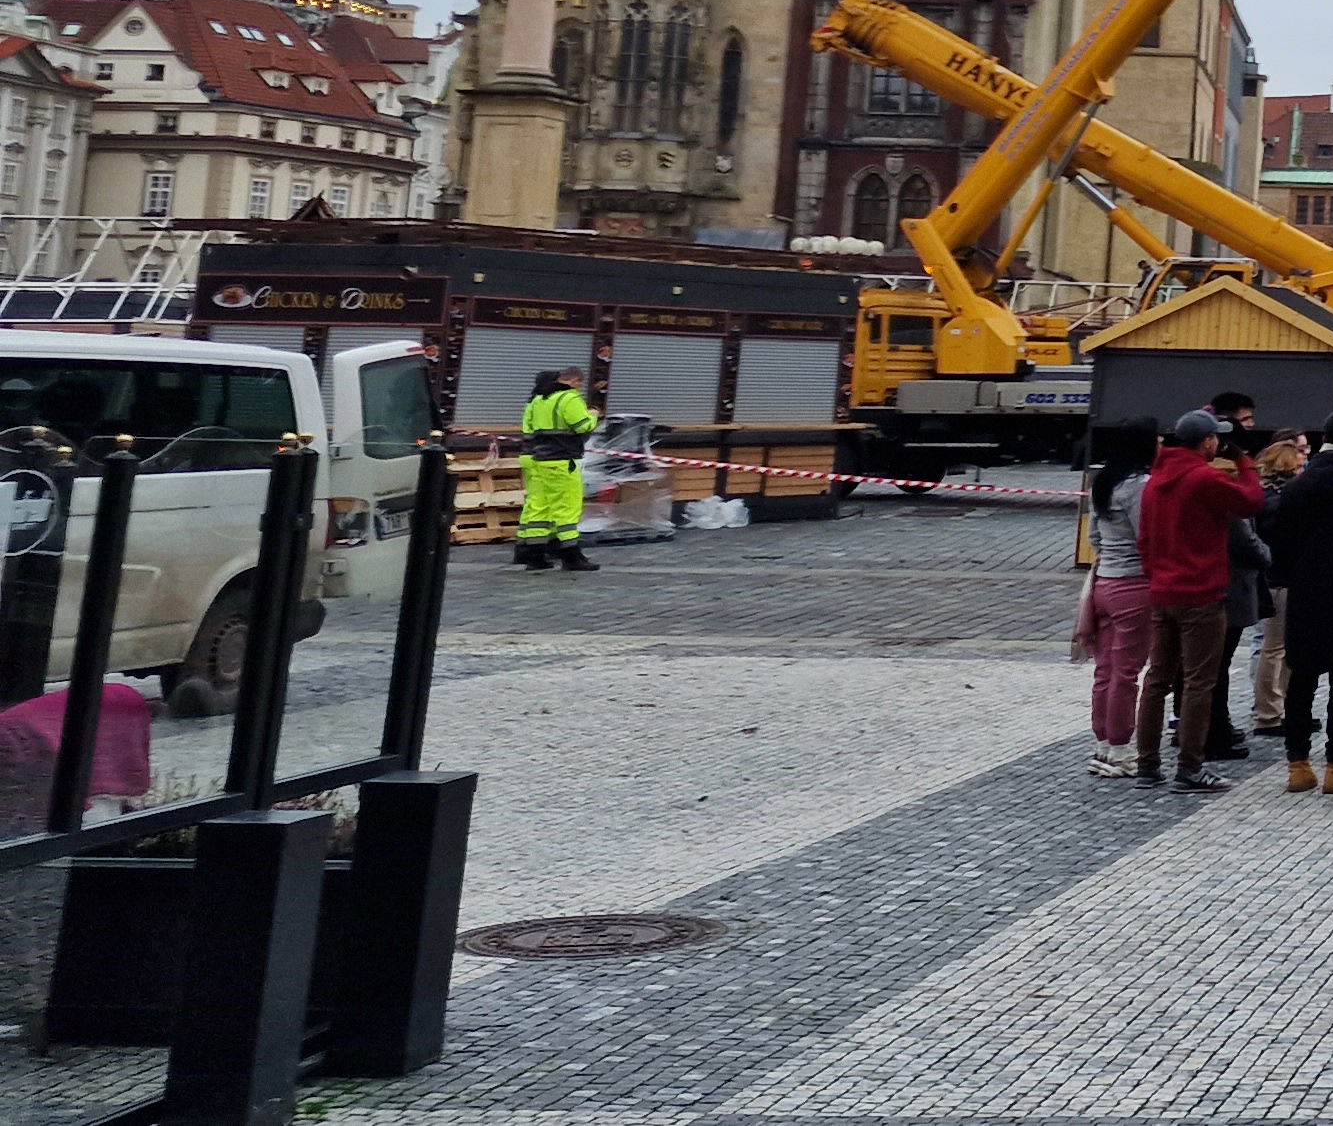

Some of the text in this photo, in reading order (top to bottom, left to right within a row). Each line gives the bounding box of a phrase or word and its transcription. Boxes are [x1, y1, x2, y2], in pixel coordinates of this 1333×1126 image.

[251, 285, 321, 309] CHICKEN
[340, 288, 405, 309] DRINKS
[1026, 393, 1057, 404] 602
